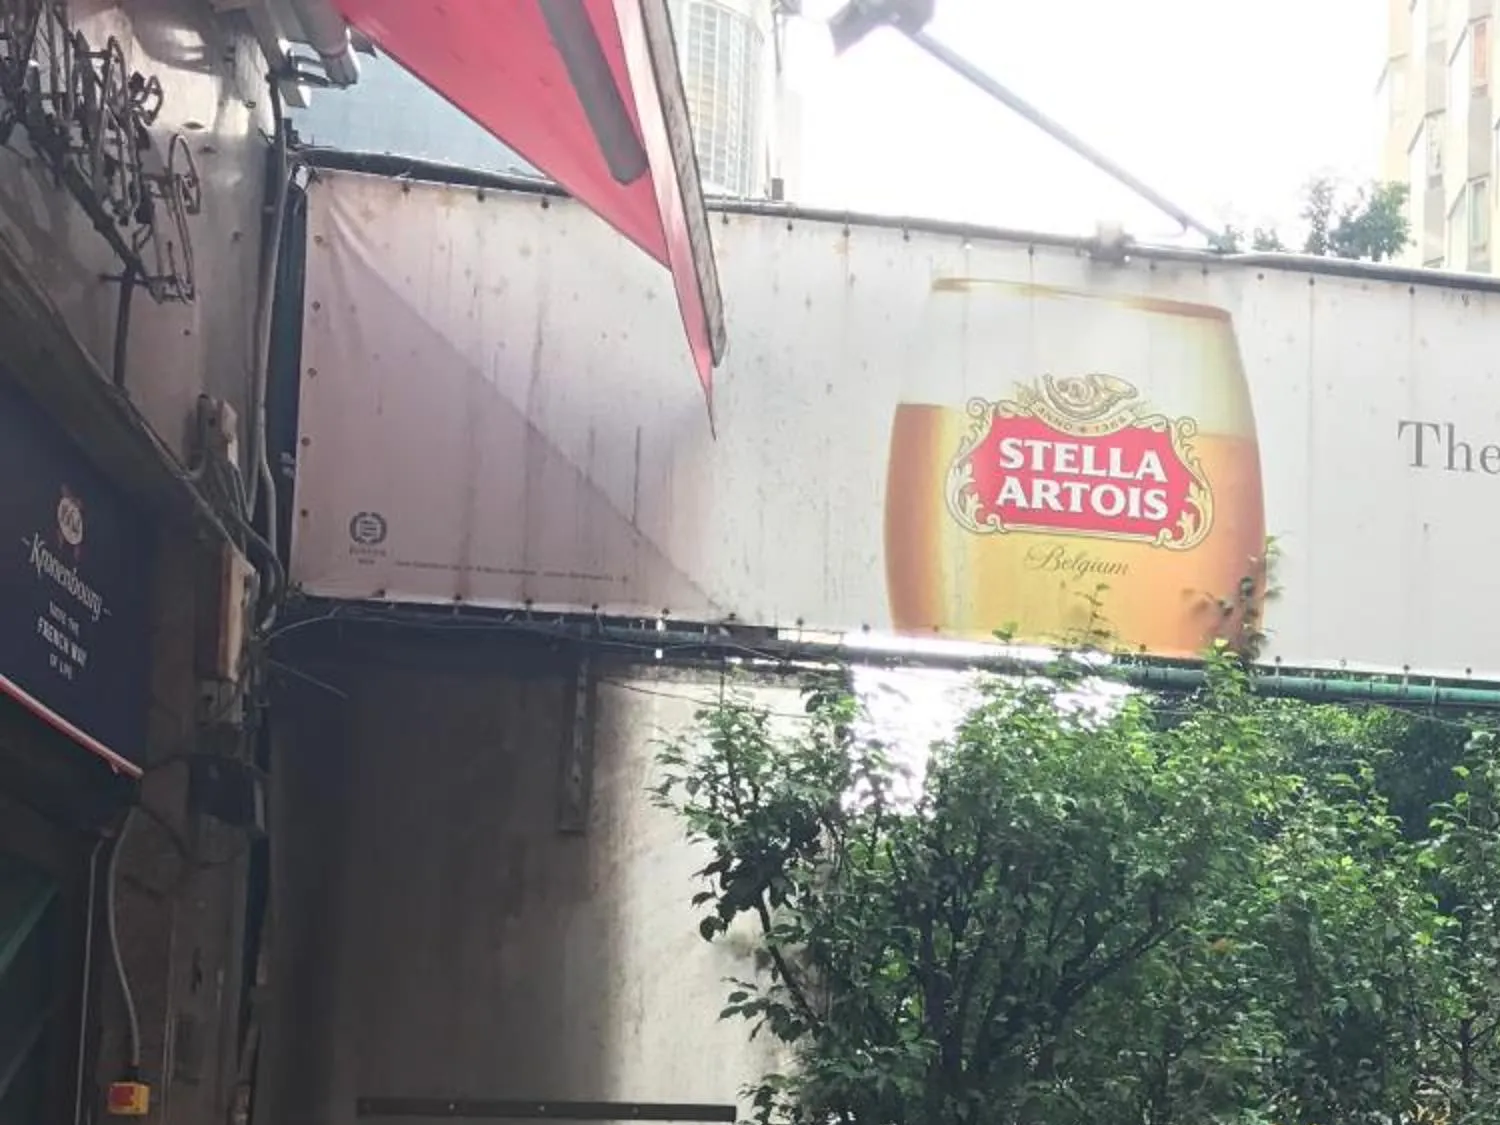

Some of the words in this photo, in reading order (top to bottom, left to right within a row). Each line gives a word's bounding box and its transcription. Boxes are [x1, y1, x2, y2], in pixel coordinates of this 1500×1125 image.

[998, 437, 1168, 483] STELLA
[996, 475, 1168, 521] ARTOIS
[1023, 542, 1130, 580] Belgium
